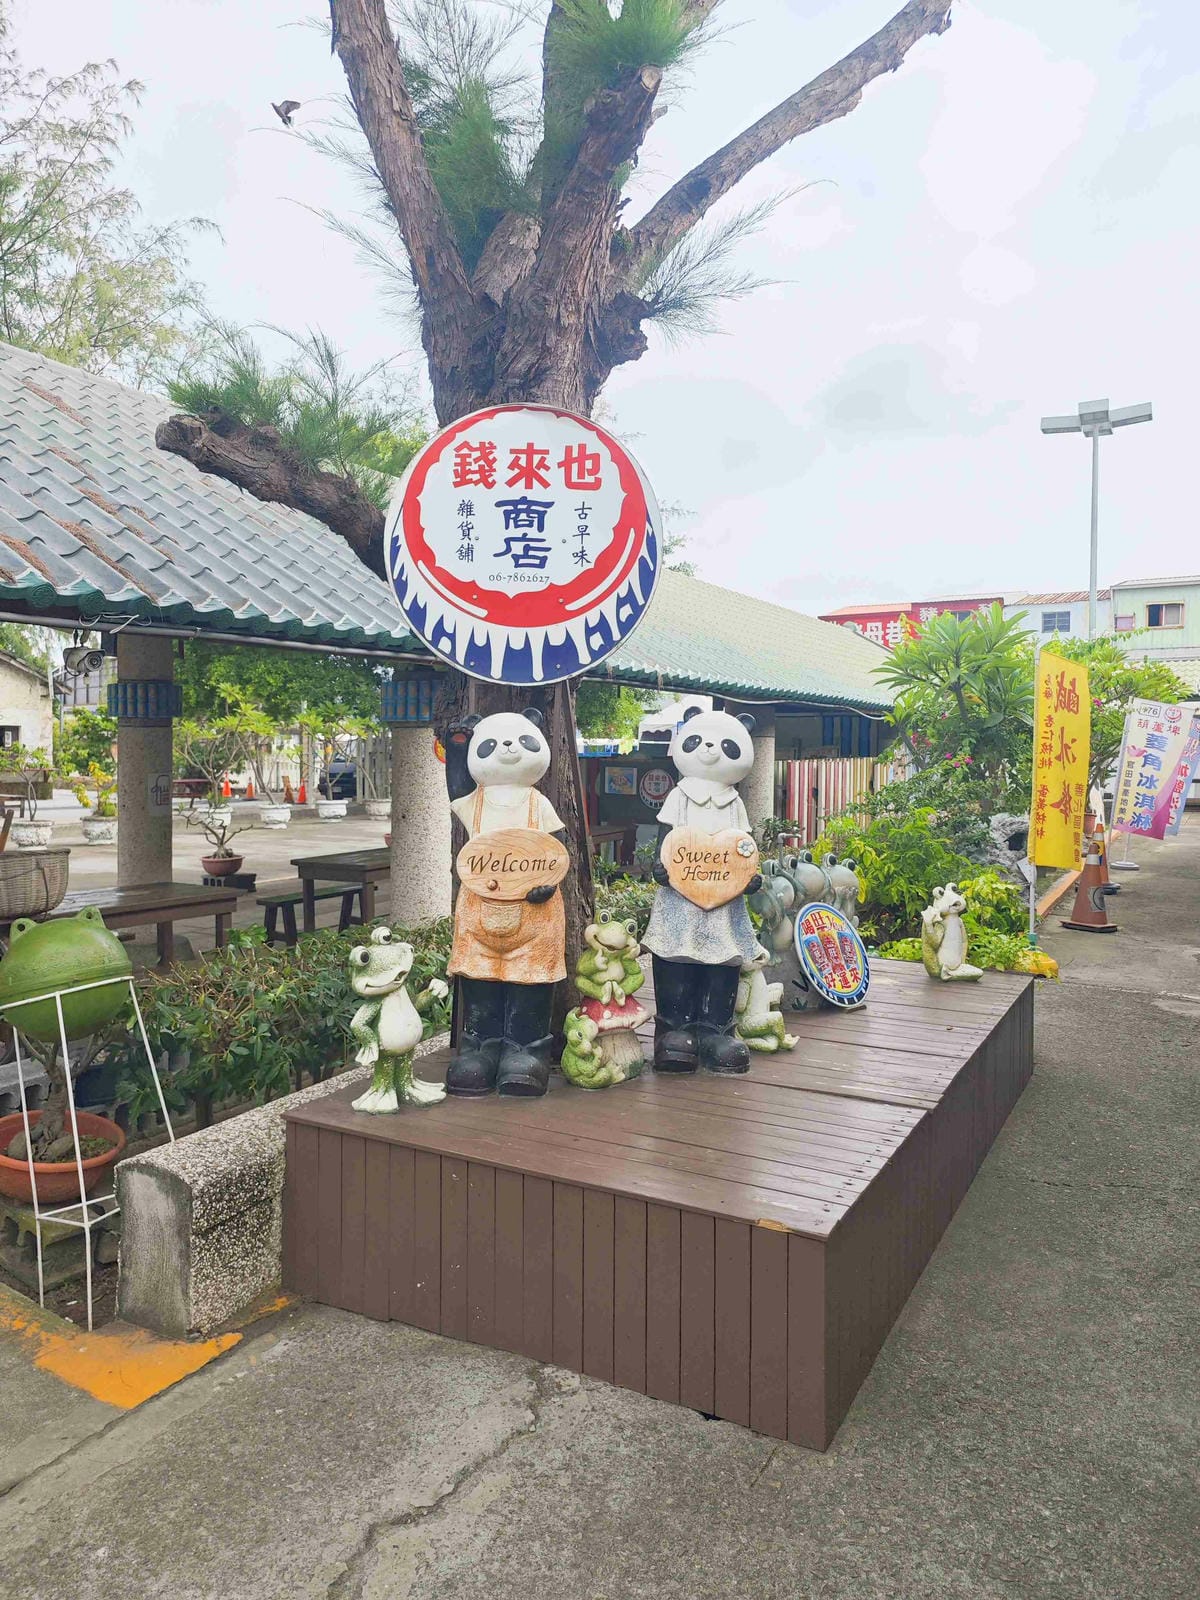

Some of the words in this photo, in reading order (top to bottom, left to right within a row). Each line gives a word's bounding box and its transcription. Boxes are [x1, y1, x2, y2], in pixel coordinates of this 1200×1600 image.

[452, 440, 602, 490] 錢來也
[493, 496, 555, 569] 商店
[572, 501, 593, 567] 古早味
[488, 572, 550, 585] 06-7862627
[1136, 718, 1182, 736] 葫蘆埤
[1129, 732, 1169, 830] 菱角冰淇淋
[466, 852, 558, 874] Welcome
[673, 846, 730, 864] Sweet
